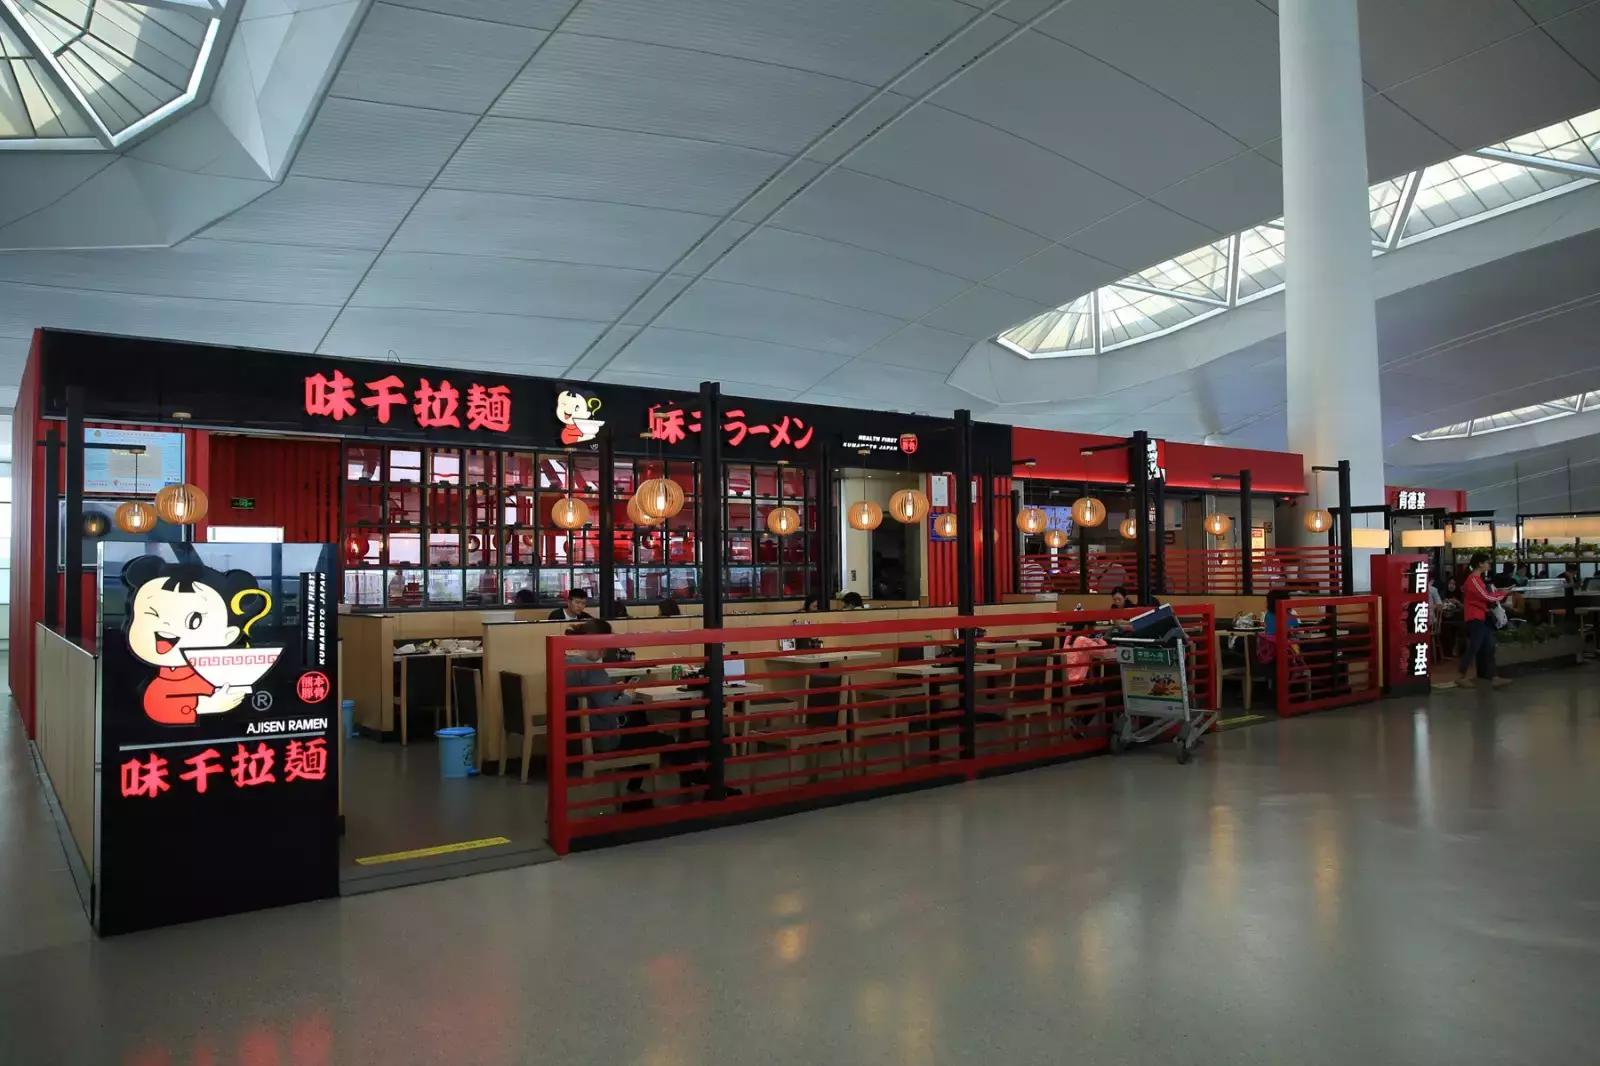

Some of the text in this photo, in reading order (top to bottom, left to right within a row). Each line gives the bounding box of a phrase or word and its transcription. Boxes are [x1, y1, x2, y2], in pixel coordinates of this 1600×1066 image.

[858, 434, 880, 443] HEALTH
[881, 436, 898, 444] FIRST
[1399, 491, 1426, 510] 肯德基
[307, 573, 316, 641] HEALTH FIRST
[1414, 561, 1429, 676] 肯德基
[246, 718, 328, 734] AJISEN RAMEN
